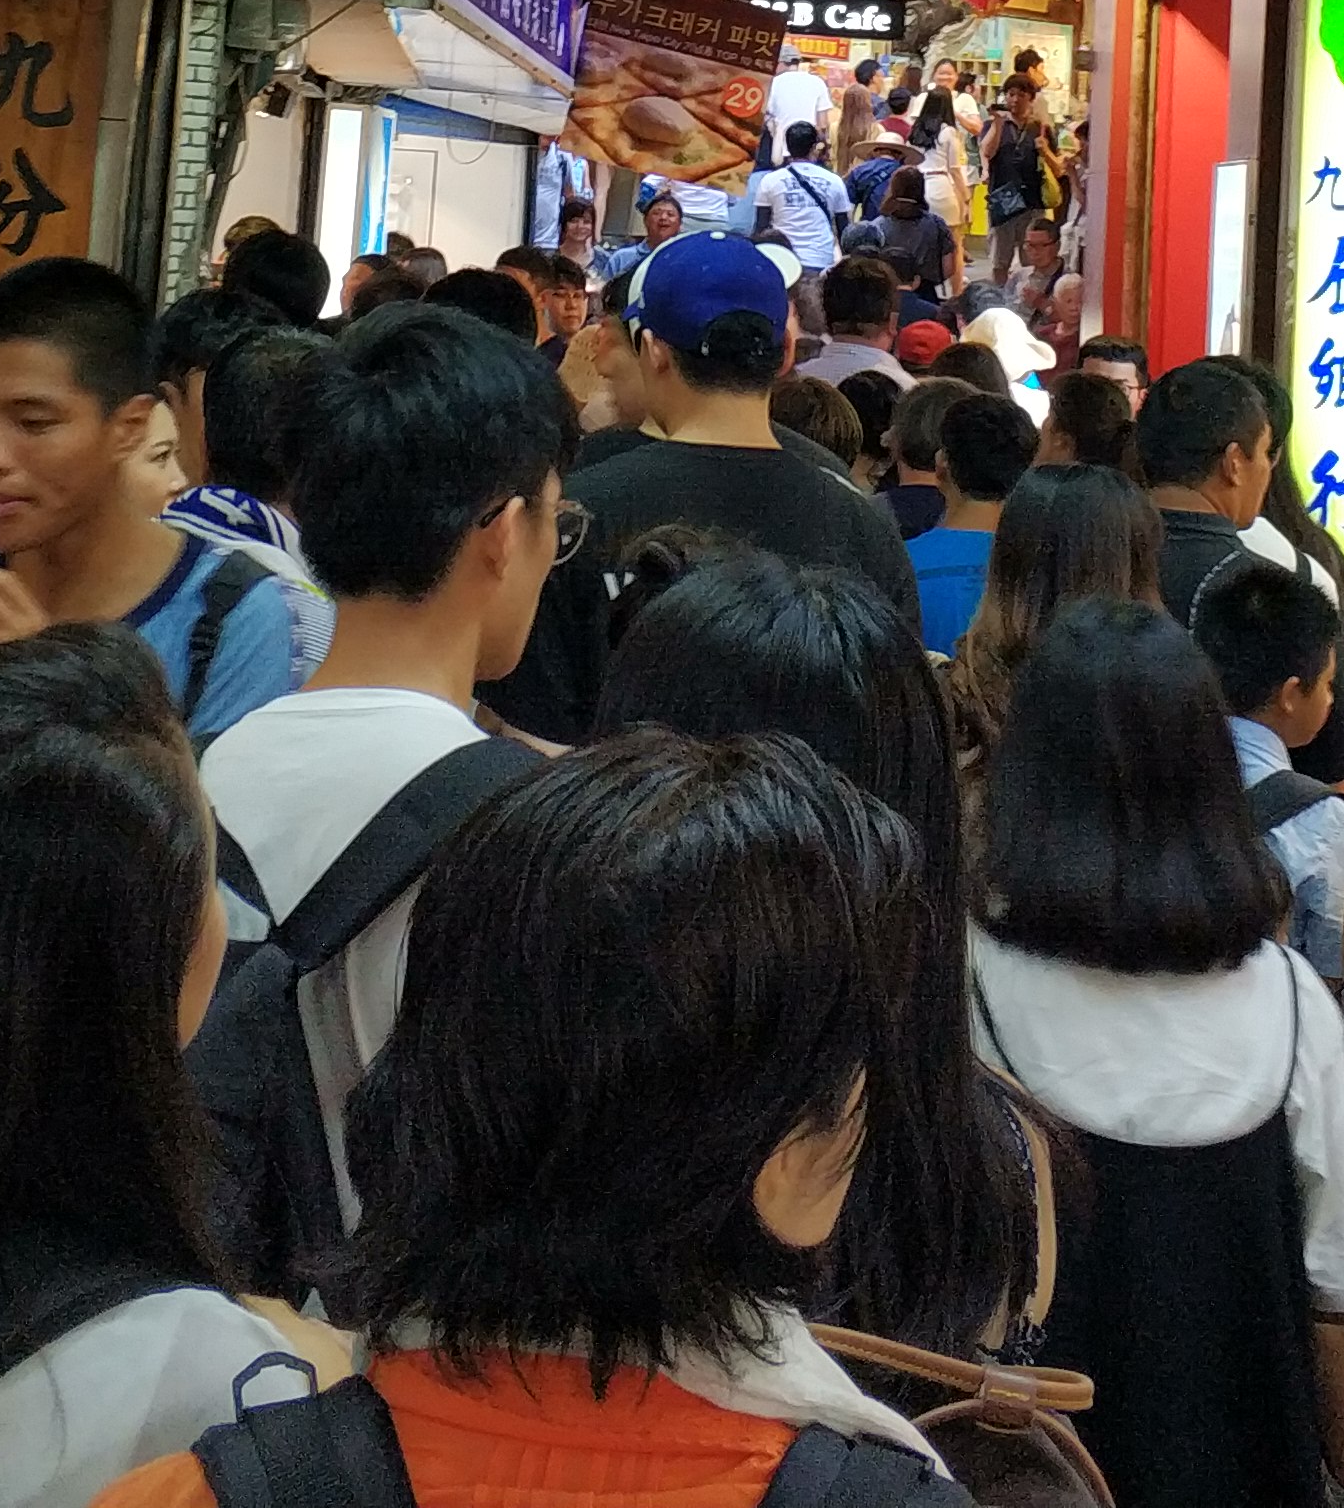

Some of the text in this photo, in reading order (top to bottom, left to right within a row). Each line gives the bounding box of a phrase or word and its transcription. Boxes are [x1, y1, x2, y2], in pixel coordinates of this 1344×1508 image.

[824, 3, 892, 32] Cafe
[726, 24, 780, 57] 파맛
[725, 82, 763, 110] 29
